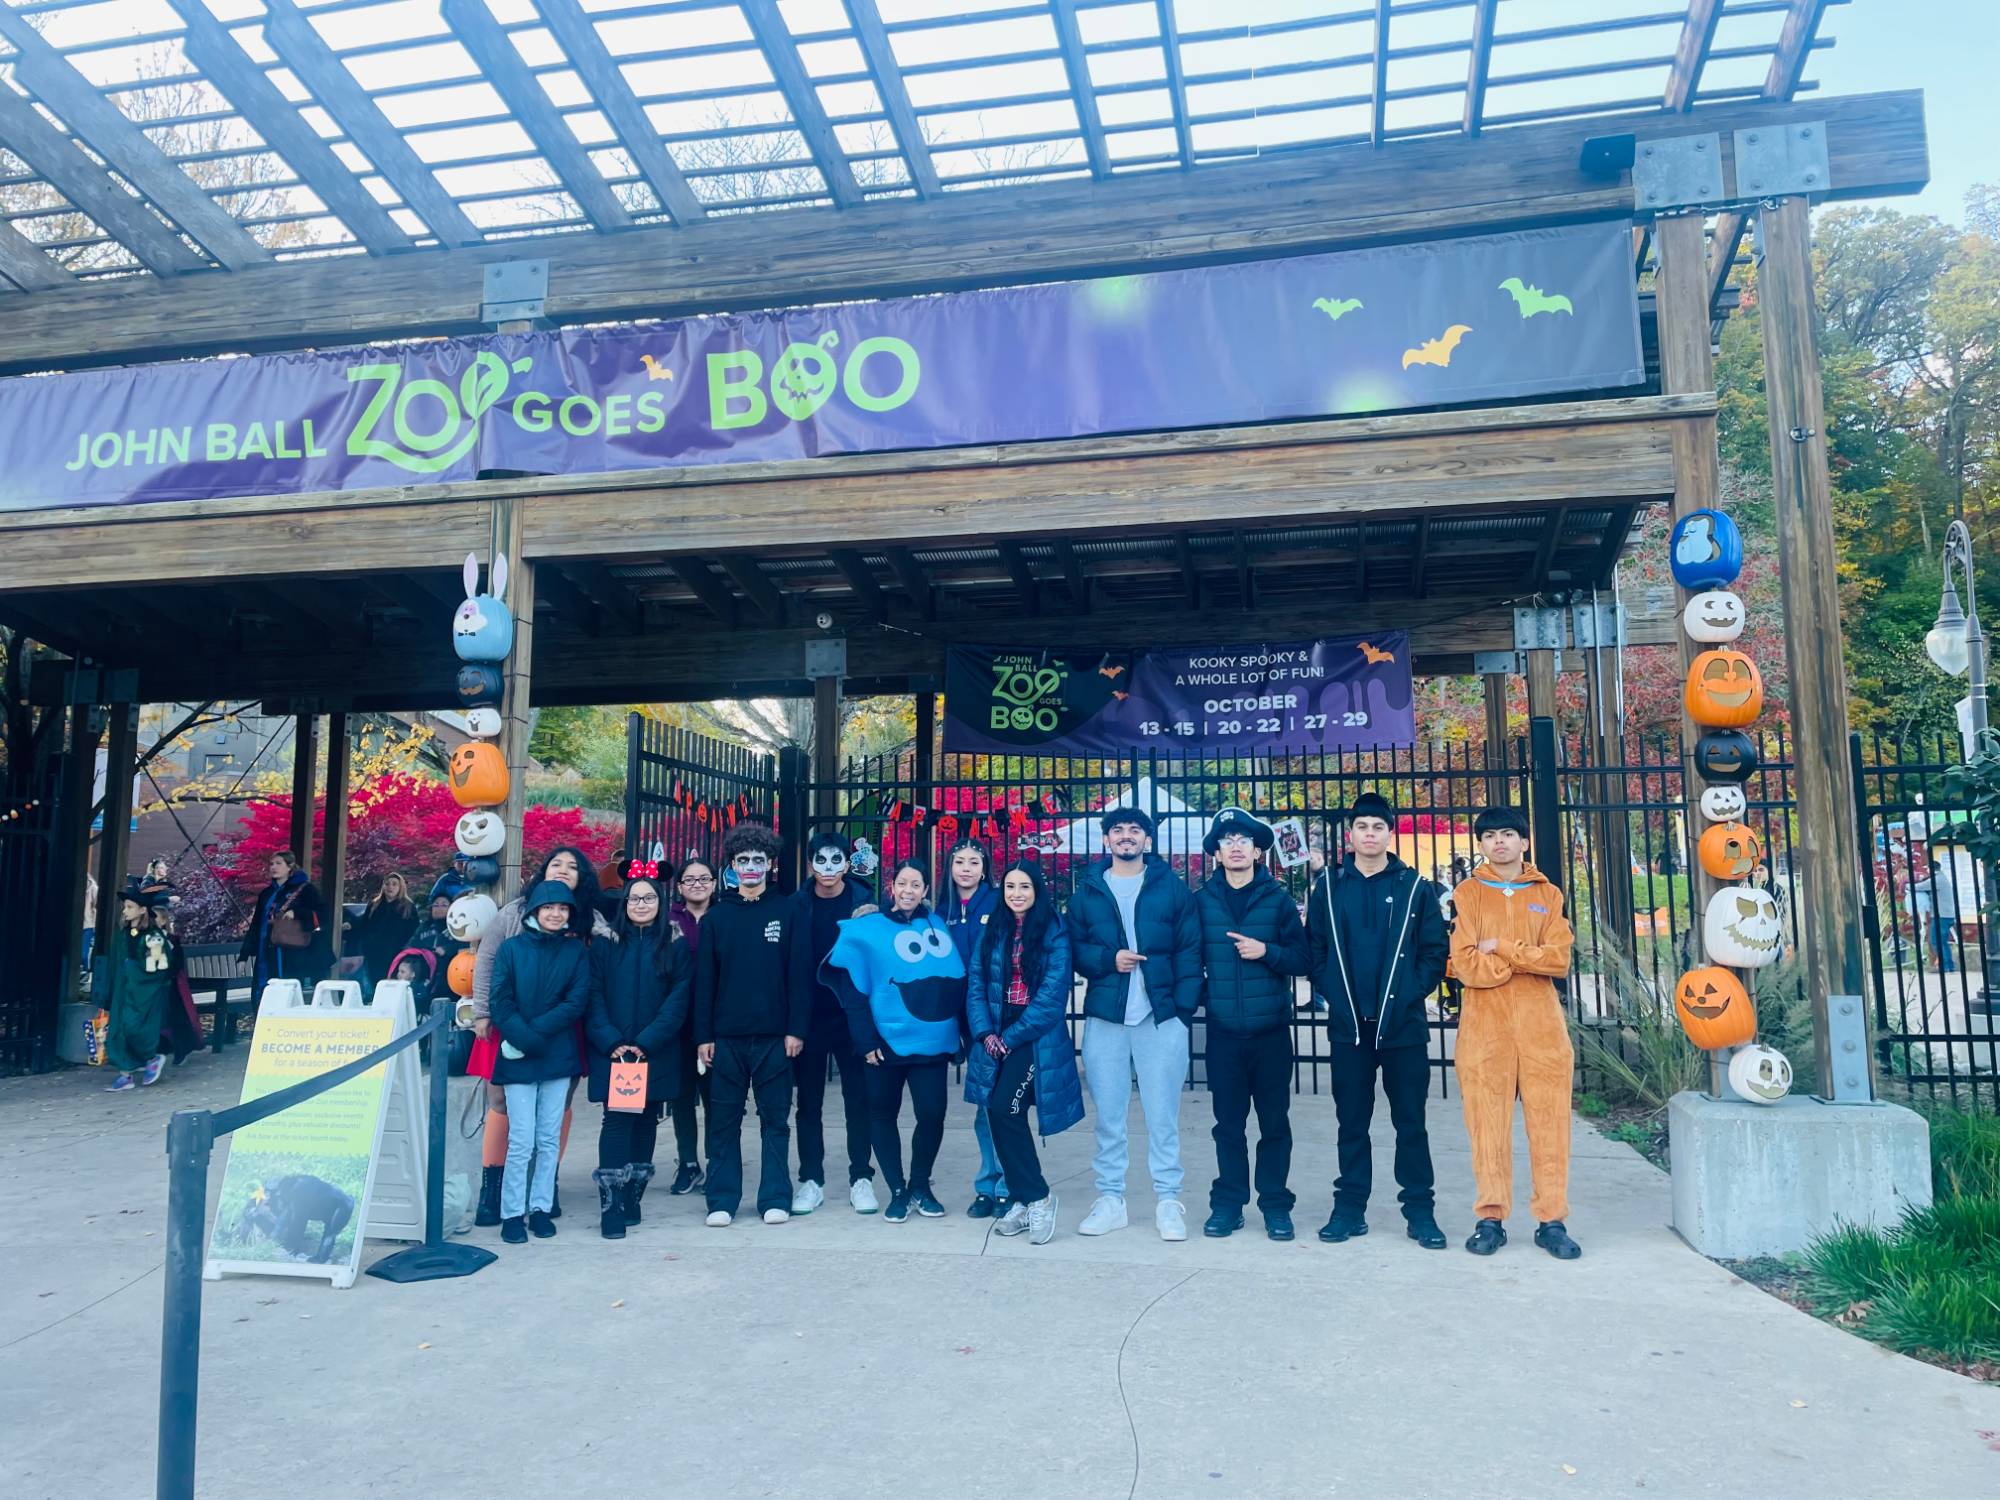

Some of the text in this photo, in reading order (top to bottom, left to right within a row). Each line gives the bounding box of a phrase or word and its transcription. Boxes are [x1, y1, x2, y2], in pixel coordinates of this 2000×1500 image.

[65, 427, 192, 472] JOHN
[207, 419, 327, 461] BALL
[512, 391, 666, 436] GOES
[706, 330, 921, 430] BOO
[1004, 655, 1032, 664] JOHN
[1015, 664, 1038, 673] BALL
[1189, 650, 1308, 669] KOOKY SPOOKY &
[1175, 666, 1325, 686] A WHOLE LOT OF FUN!
[1203, 694, 1298, 713] OCTOBER
[991, 705, 1058, 731] BOO
[1138, 721, 1161, 736] 13
[1173, 721, 1196, 736] 15
[1217, 720, 1242, 735] 20
[1256, 717, 1281, 733] 22
[1303, 714, 1328, 729] 27
[1342, 711, 1369, 727] 29
[277, 1029, 313, 1039] Convert
[316, 1031, 338, 1041] your
[261, 1043, 312, 1054] BECOME
[314, 1044, 323, 1054] A
[273, 1058, 288, 1068] for
[297, 1060, 329, 1068] season
[1010, 1064, 1036, 1114] SPYDER
